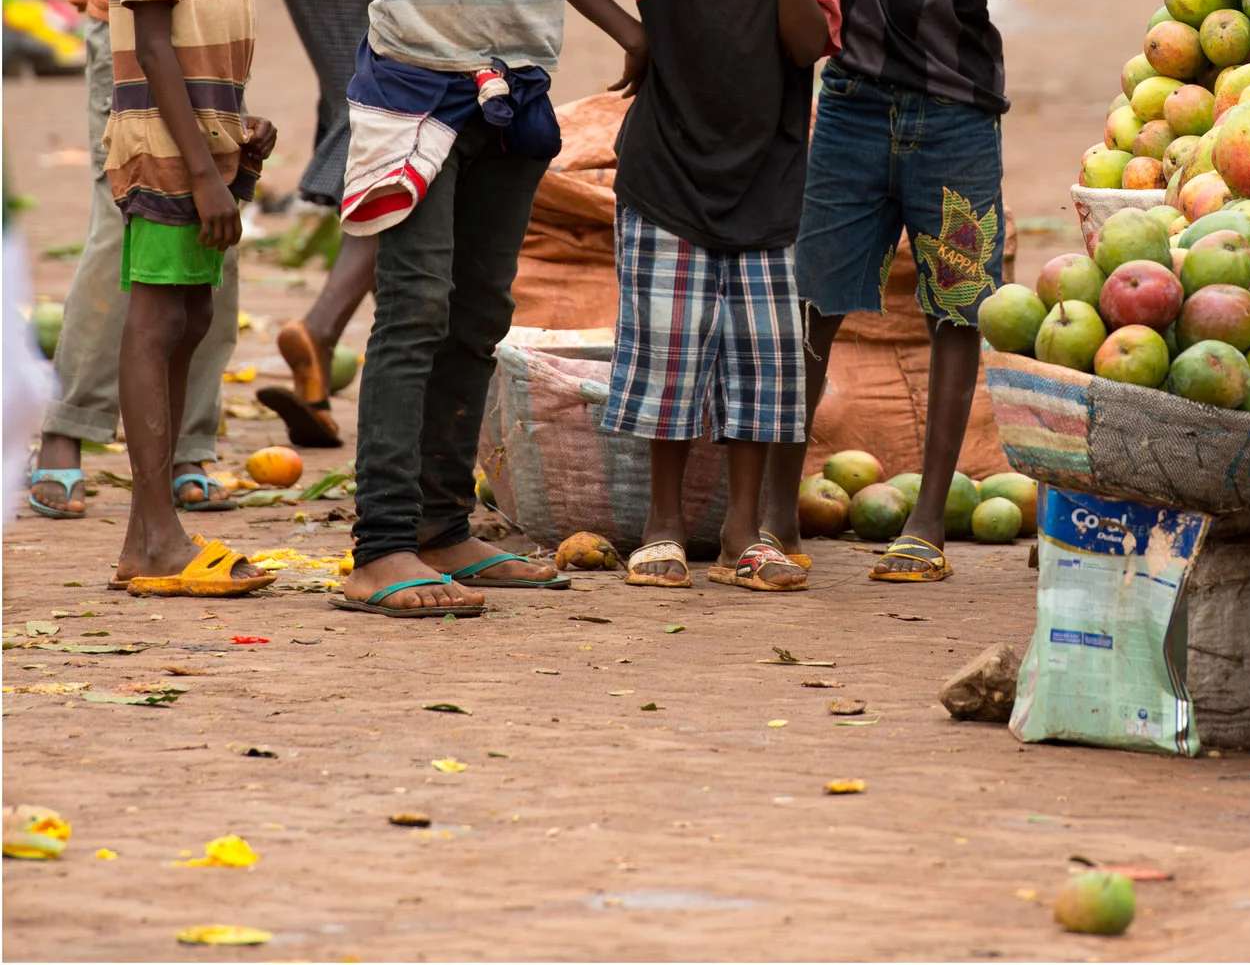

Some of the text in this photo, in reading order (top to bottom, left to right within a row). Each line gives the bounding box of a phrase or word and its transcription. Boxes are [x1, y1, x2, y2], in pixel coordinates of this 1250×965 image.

[937, 243, 979, 276] KAPPA
[1071, 508, 1128, 534] Coral
[1096, 531, 1122, 543] Dulux
